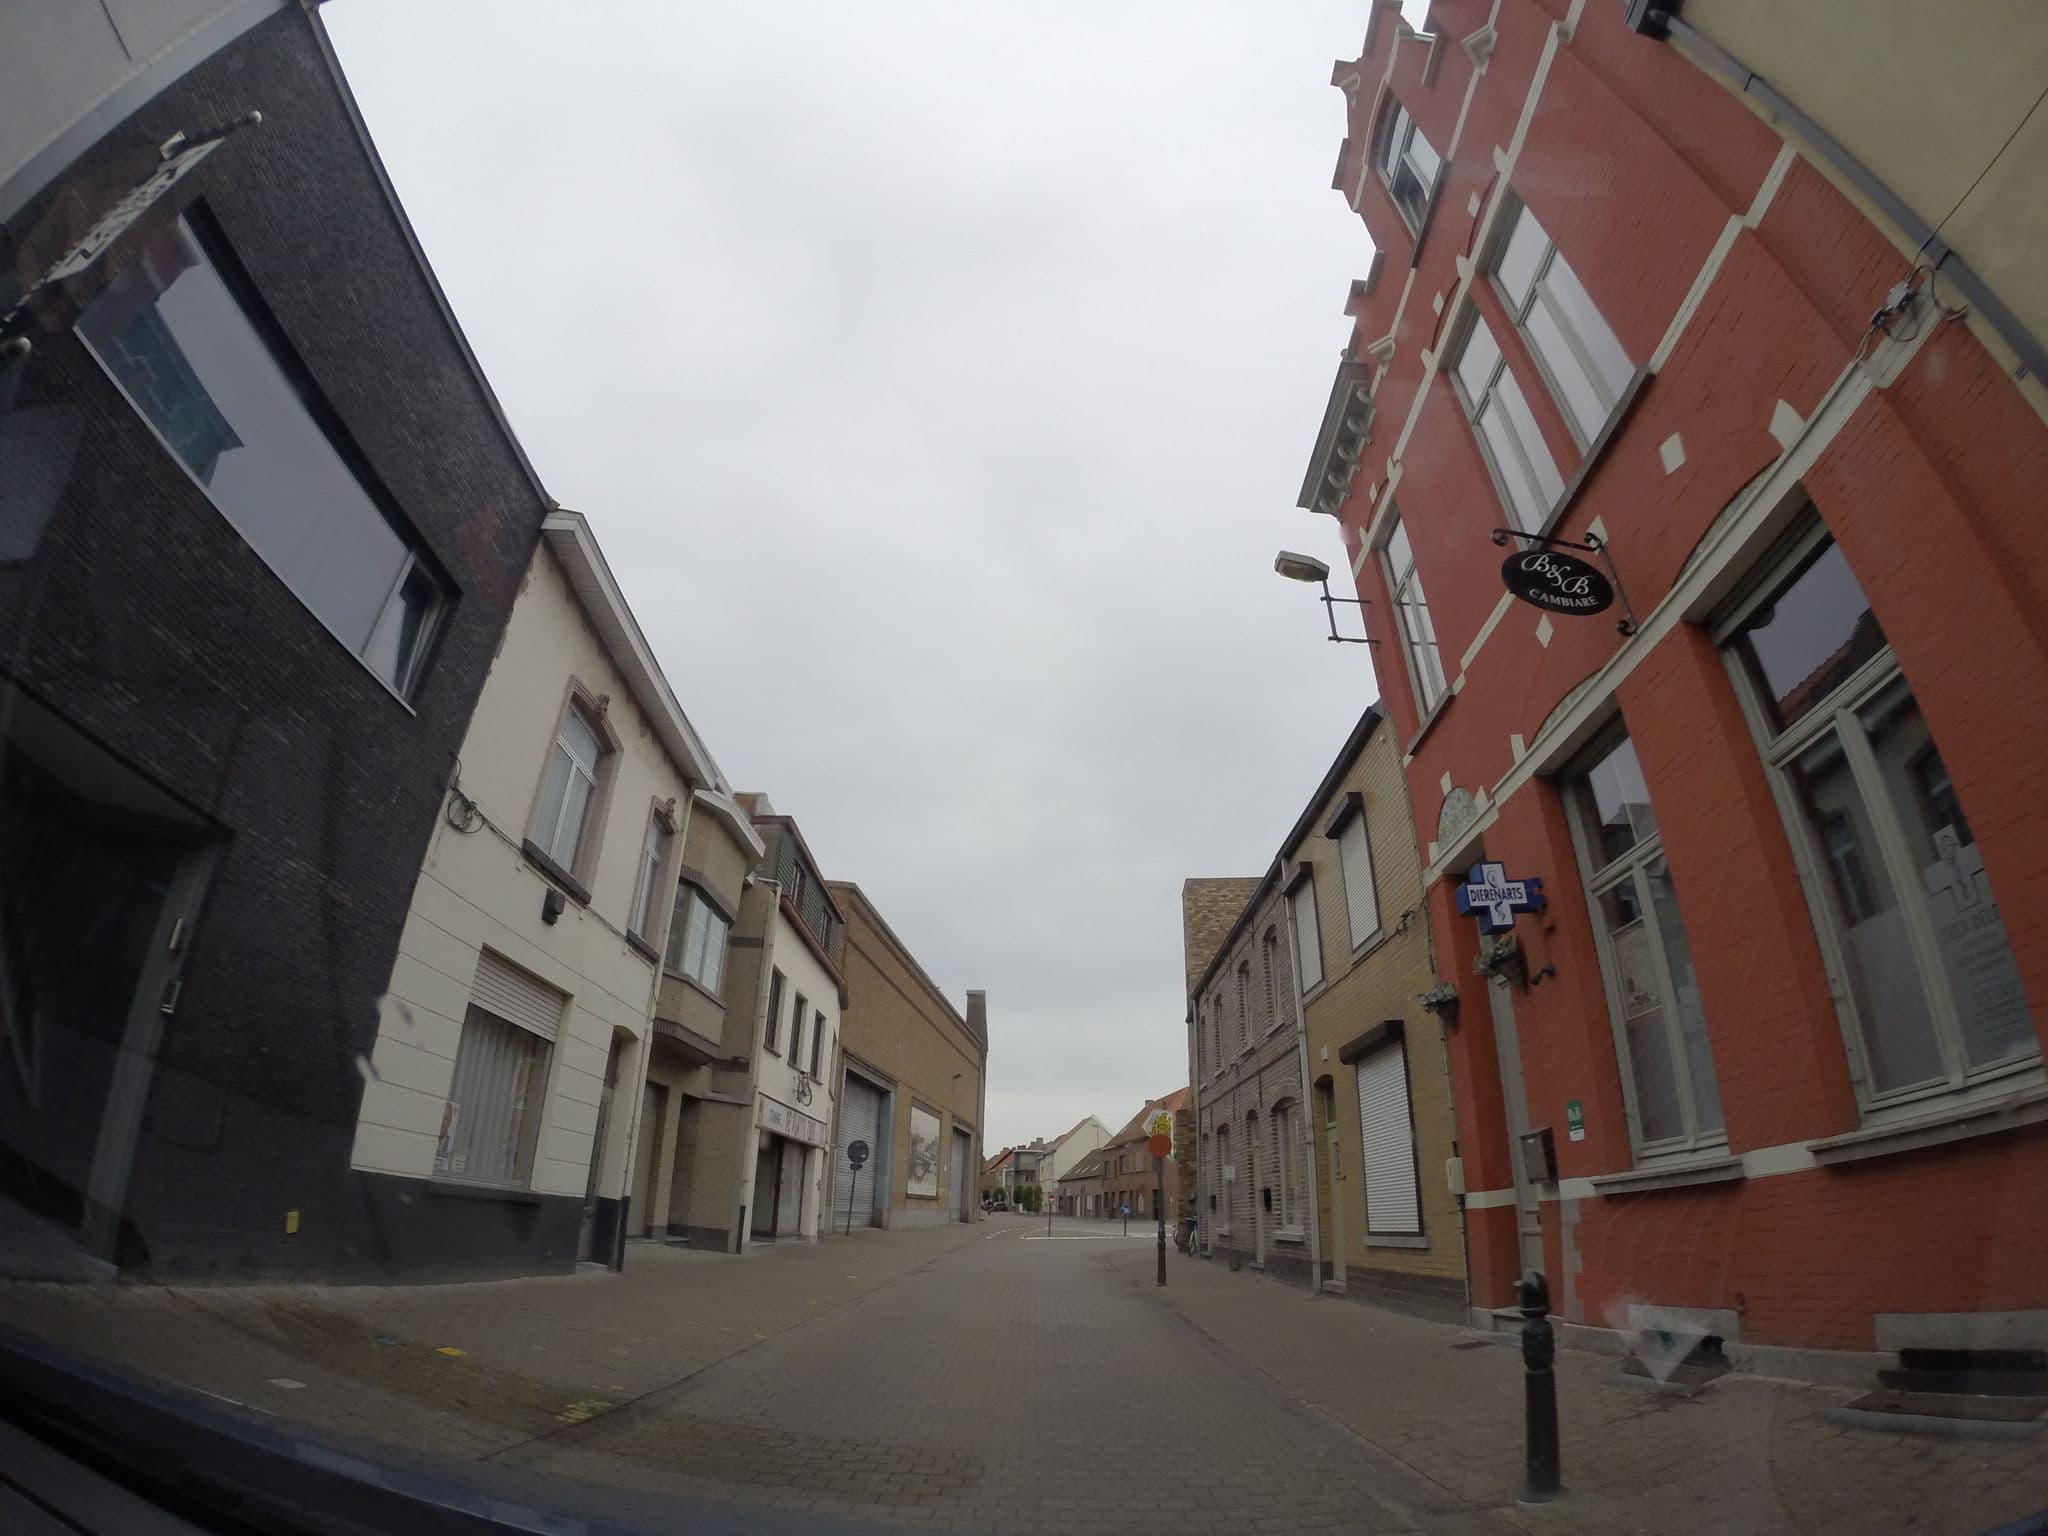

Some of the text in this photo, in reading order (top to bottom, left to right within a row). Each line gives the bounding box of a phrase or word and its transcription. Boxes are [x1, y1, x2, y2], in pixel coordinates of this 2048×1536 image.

[1520, 552, 1591, 595] B&B
[1529, 588, 1598, 607] CAMBIARE
[1470, 887, 1523, 902] DIERENARTS
